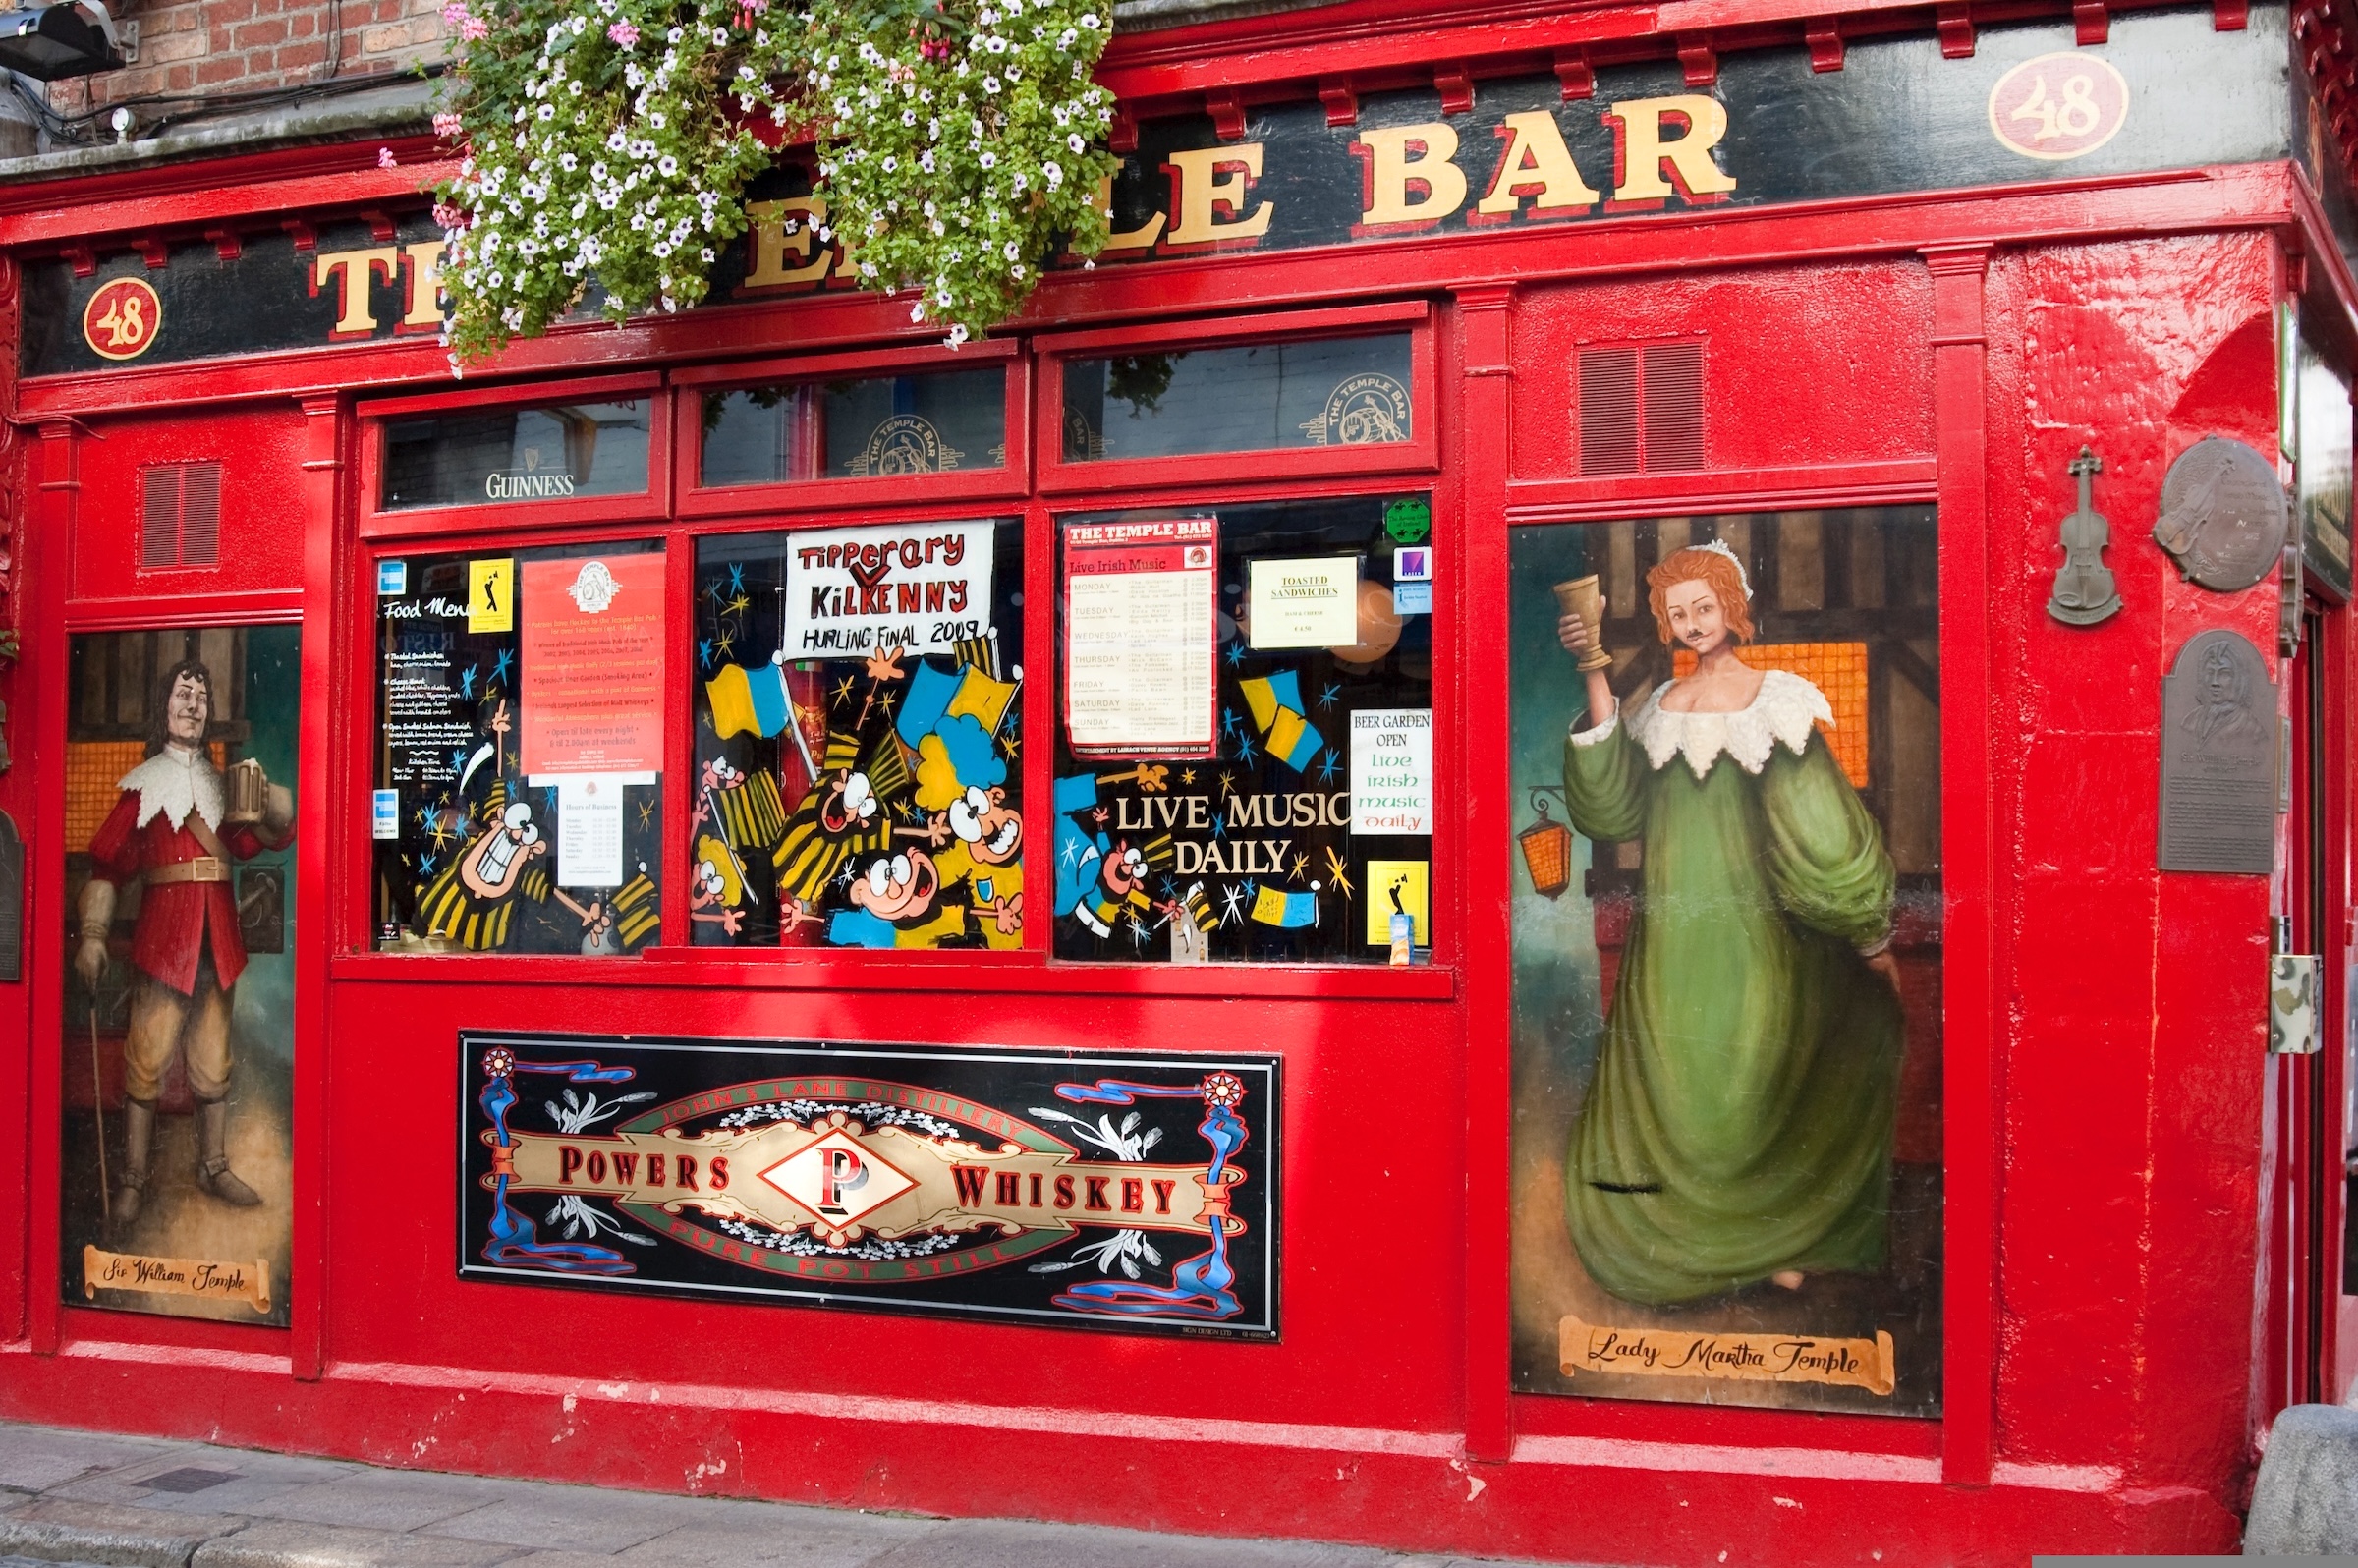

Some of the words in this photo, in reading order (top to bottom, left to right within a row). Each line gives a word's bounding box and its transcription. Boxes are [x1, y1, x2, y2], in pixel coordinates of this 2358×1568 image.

[2010, 74, 2101, 141] 48
[1352, 94, 1737, 234] BAR
[96, 297, 144, 347] 48
[1329, 398, 1343, 426] THE
[1340, 378, 1392, 397] TEMPLE
[1391, 390, 1405, 419] BAR
[870, 438, 882, 464] THE
[879, 420, 926, 436] TEMPLE
[923, 430, 936, 458] BAR
[1072, 418, 1085, 445] BAR
[1070, 528, 1102, 540] THE
[1105, 524, 1174, 538] TEMPLE
[1177, 522, 1212, 535] BAR
[583, 563, 604, 574] TEMPLE
[1070, 561, 1095, 573] Live
[1097, 559, 1126, 572] Irish
[1129, 557, 1166, 570] Music
[1074, 583, 1111, 591] MONDAY
[1271, 588, 1338, 597] SANDWICHES
[1281, 576, 1328, 586] TOASTED
[382, 598, 422, 619] Food
[931, 620, 981, 643] 2009
[1075, 631, 1128, 640] WEDNESDAY
[1075, 700, 1120, 708] SATURDAY
[551, 728, 569, 738] Open
[594, 727, 613, 736] every
[615, 725, 634, 735] night
[1354, 715, 1380, 728] BEER
[1383, 714, 1431, 728] GARDEN
[601, 737, 636, 746] weekends
[1376, 734, 1407, 747] OPEN
[1116, 795, 1209, 831] LIVE
[1228, 791, 1352, 828] MUSIC
[1174, 839, 1292, 875] DAILY
[661, 1088, 758, 1125] JOHN'S
[773, 1081, 848, 1098] LANE
[866, 1084, 1026, 1138] DISTILLERY
[558, 1145, 730, 1190] POWERS
[817, 1146, 870, 1216] P
[950, 1164, 1177, 1214] WHISKEY
[668, 1219, 768, 1265] PURE
[798, 1260, 877, 1278] POT
[903, 1247, 1016, 1278] STILL
[103, 1258, 128, 1281] Sir
[133, 1259, 186, 1285] William
[192, 1264, 246, 1293] Temple
[1588, 1333, 1661, 1367] Lady
[1661, 1338, 1766, 1372] Martha
[1765, 1341, 1863, 1375] Temple
